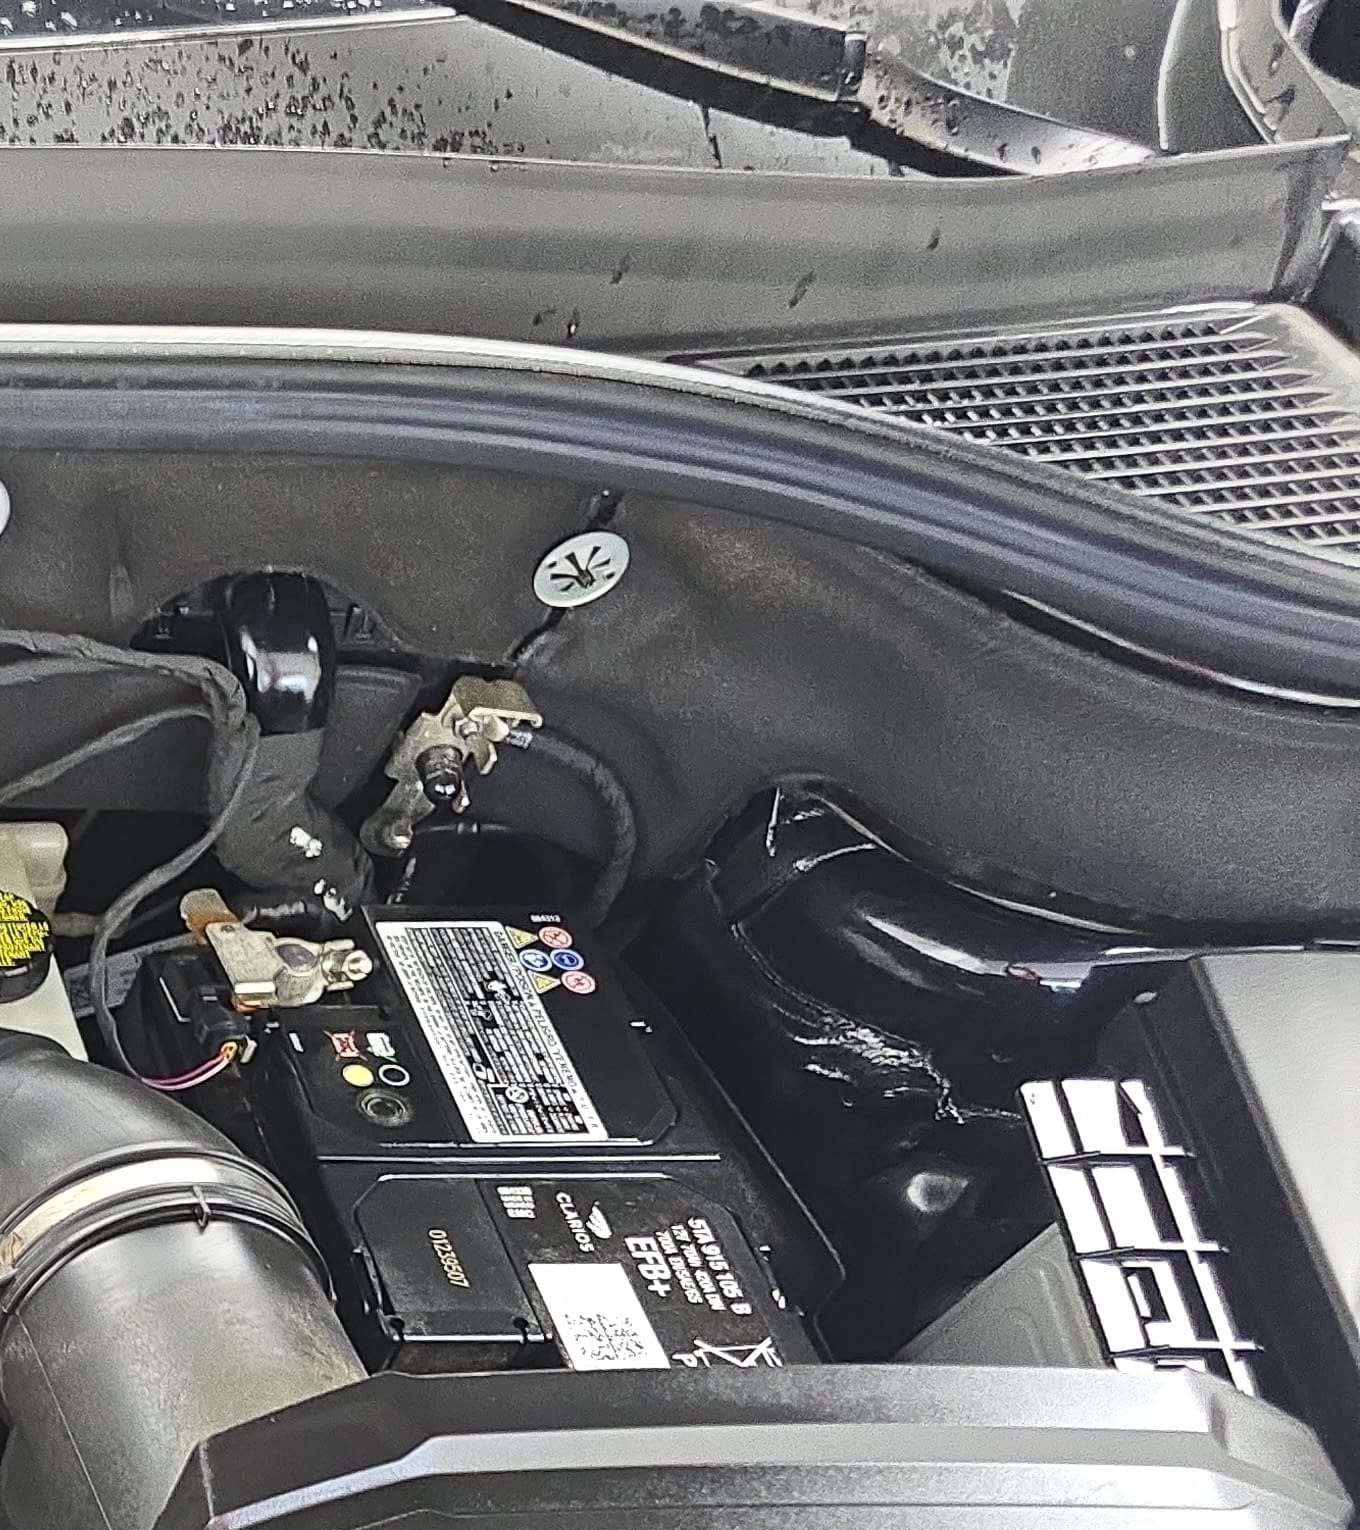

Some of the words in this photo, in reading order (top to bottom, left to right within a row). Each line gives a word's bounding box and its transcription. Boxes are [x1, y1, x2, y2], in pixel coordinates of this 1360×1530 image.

[556, 1192, 594, 1253] CLARIOS
[624, 1236, 672, 1298] EFB+
[701, 1243, 730, 1271] 915
[715, 1271, 744, 1299] 105
